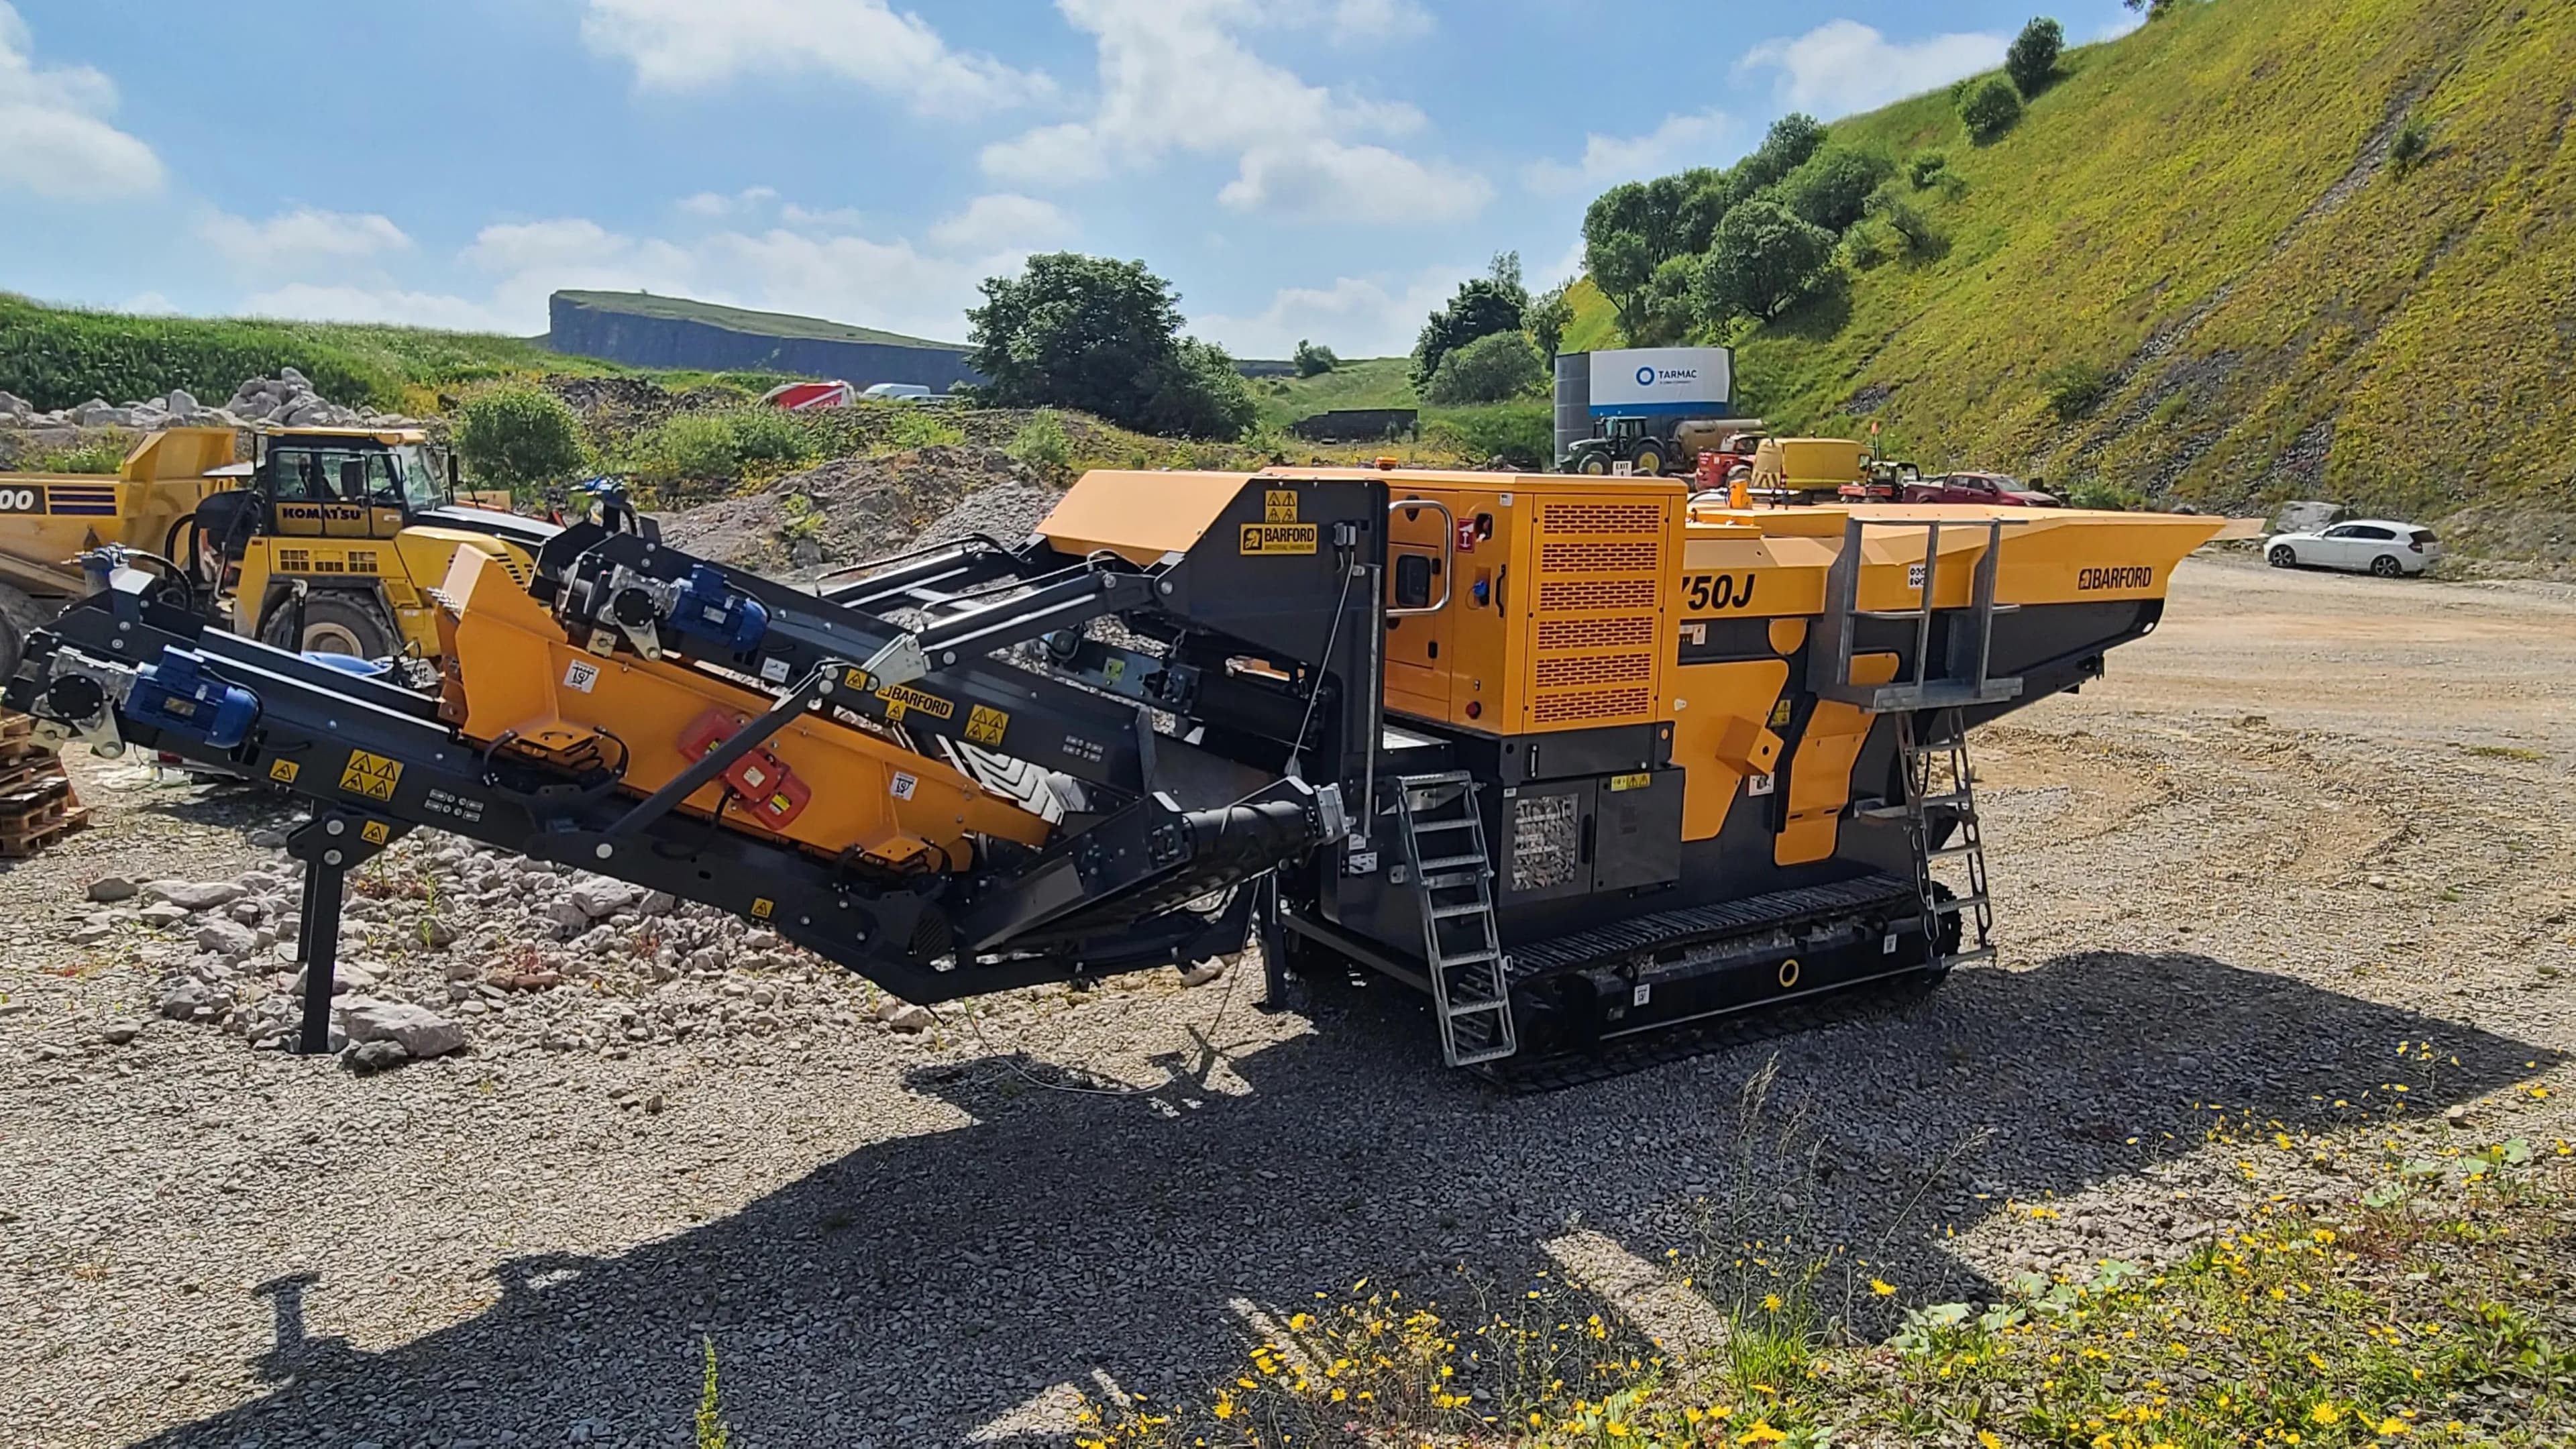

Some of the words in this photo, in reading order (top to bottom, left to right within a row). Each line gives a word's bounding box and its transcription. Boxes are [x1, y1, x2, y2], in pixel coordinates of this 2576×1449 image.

[1658, 370, 1697, 379] TARMAC
[282, 506, 361, 520] KOMATSU
[1265, 527, 1315, 543] BARFORD
[2092, 567, 2153, 590] BARFORD
[891, 685, 950, 716] BARFORD
